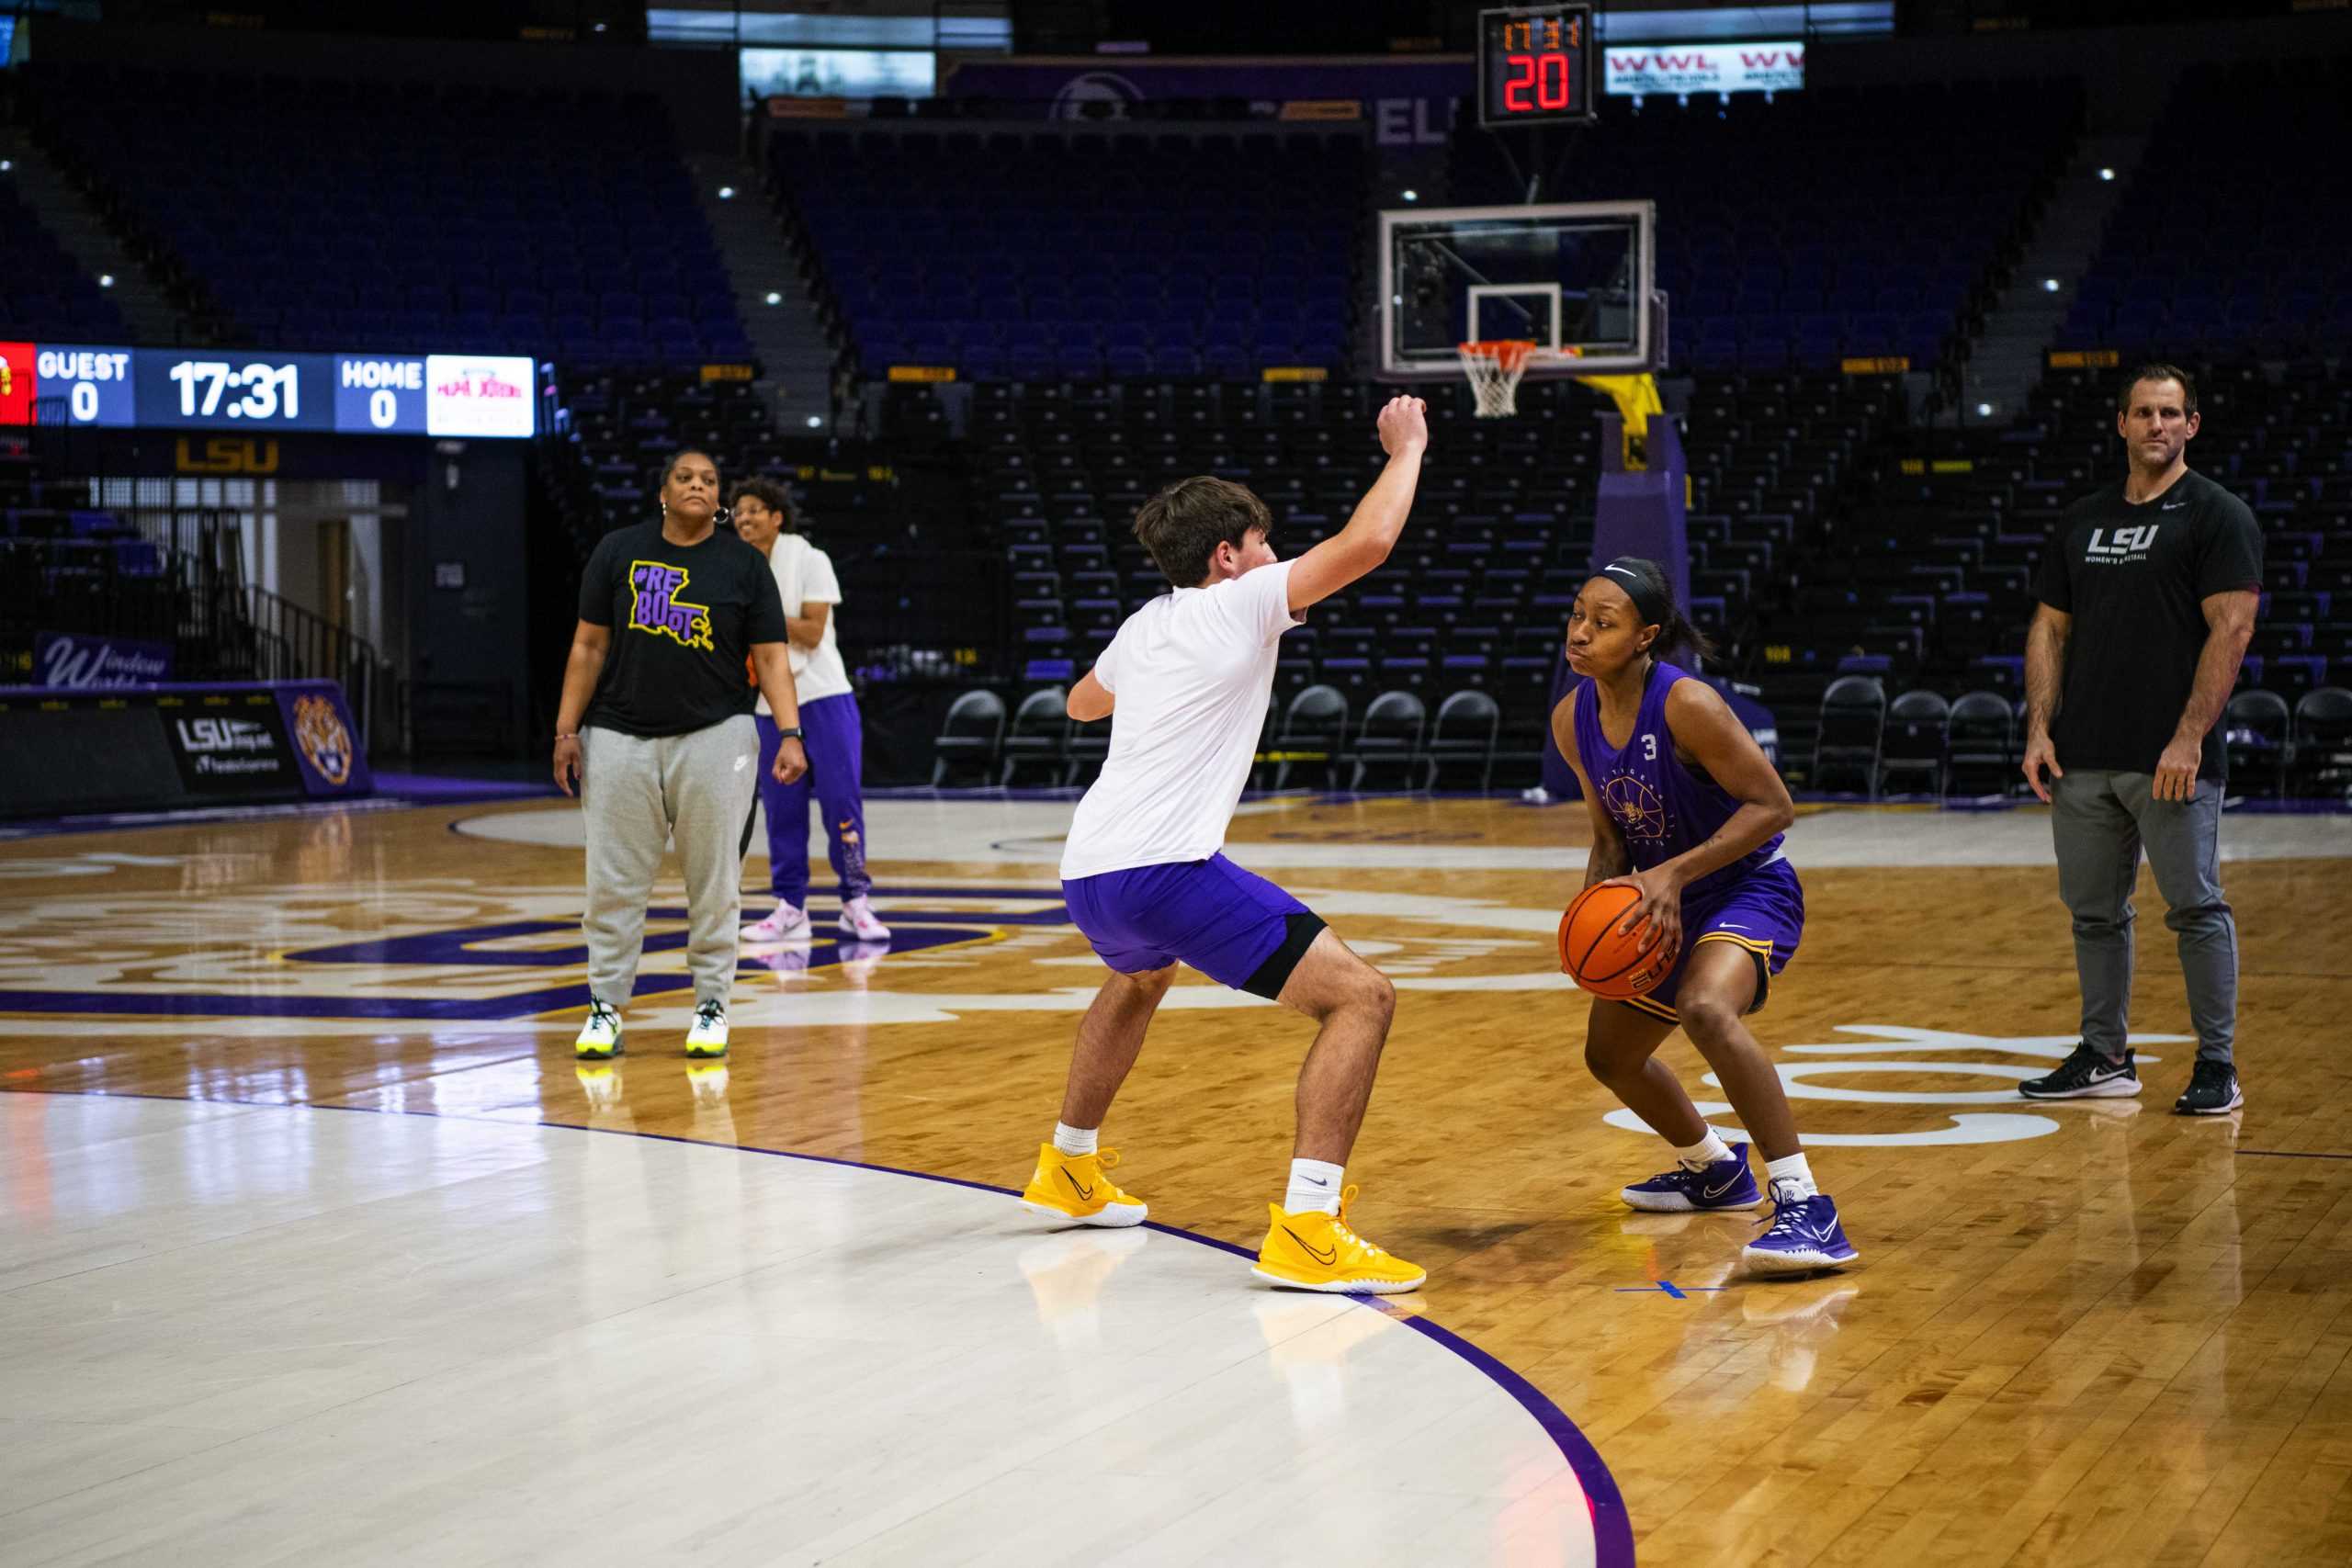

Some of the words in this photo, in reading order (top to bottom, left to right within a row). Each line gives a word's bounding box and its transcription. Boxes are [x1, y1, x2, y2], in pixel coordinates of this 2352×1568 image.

[1504, 53, 1569, 111] 20
[38, 351, 129, 380] GUEST
[342, 360, 423, 389] HOME
[72, 380, 98, 422] 0
[170, 361, 299, 419] 17:31
[370, 389, 397, 429] 0
[175, 438, 279, 472] LSU
[2087, 525, 2159, 554] LSU
[634, 566, 683, 592] #RE
[176, 718, 233, 751] LSU
[1641, 734, 1657, 761] 3
